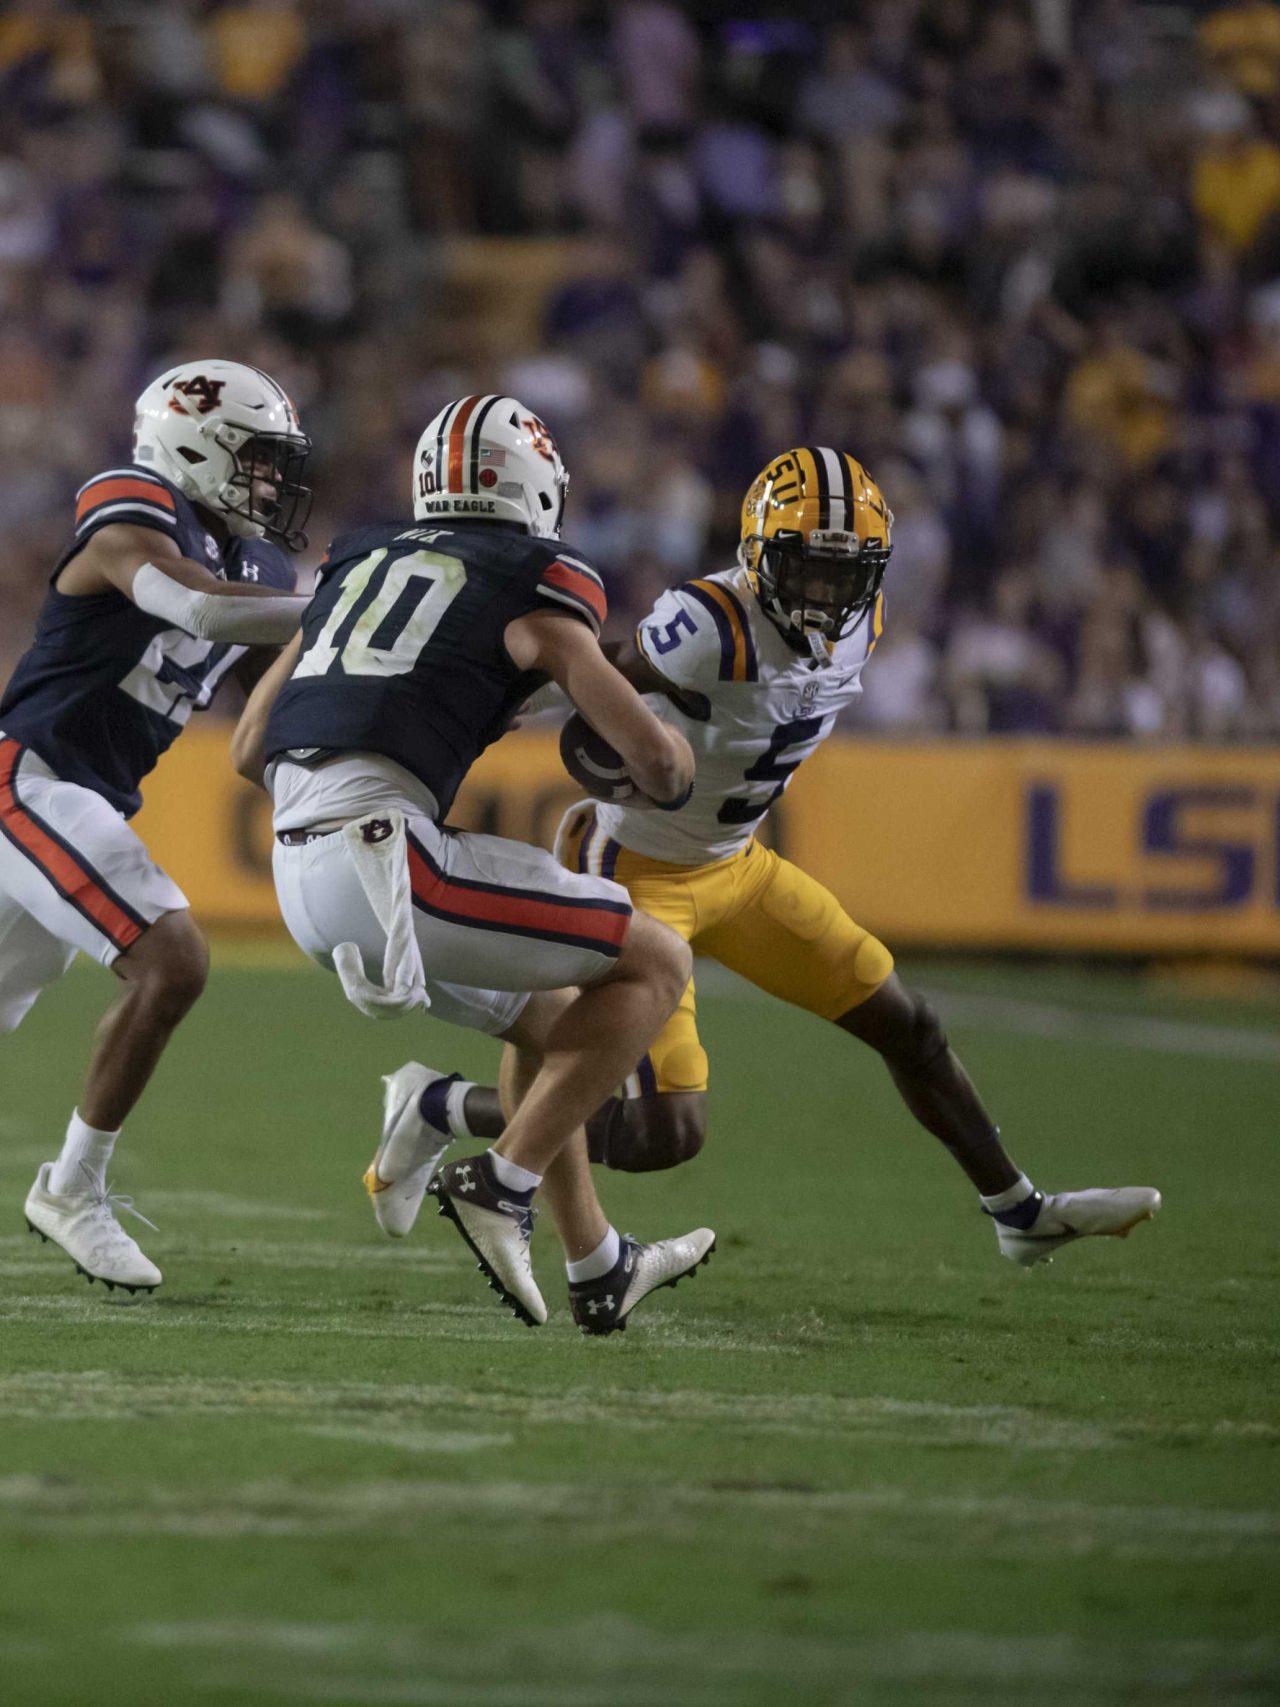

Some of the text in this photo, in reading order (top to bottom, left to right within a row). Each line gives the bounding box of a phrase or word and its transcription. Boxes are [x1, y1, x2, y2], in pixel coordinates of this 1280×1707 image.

[419, 470, 437, 498] 10
[425, 500, 496, 514] WAR EAGLE
[290, 546, 468, 680] 10
[649, 608, 698, 655] 5
[717, 716, 824, 824] 5
[1024, 777, 1280, 914] LS
